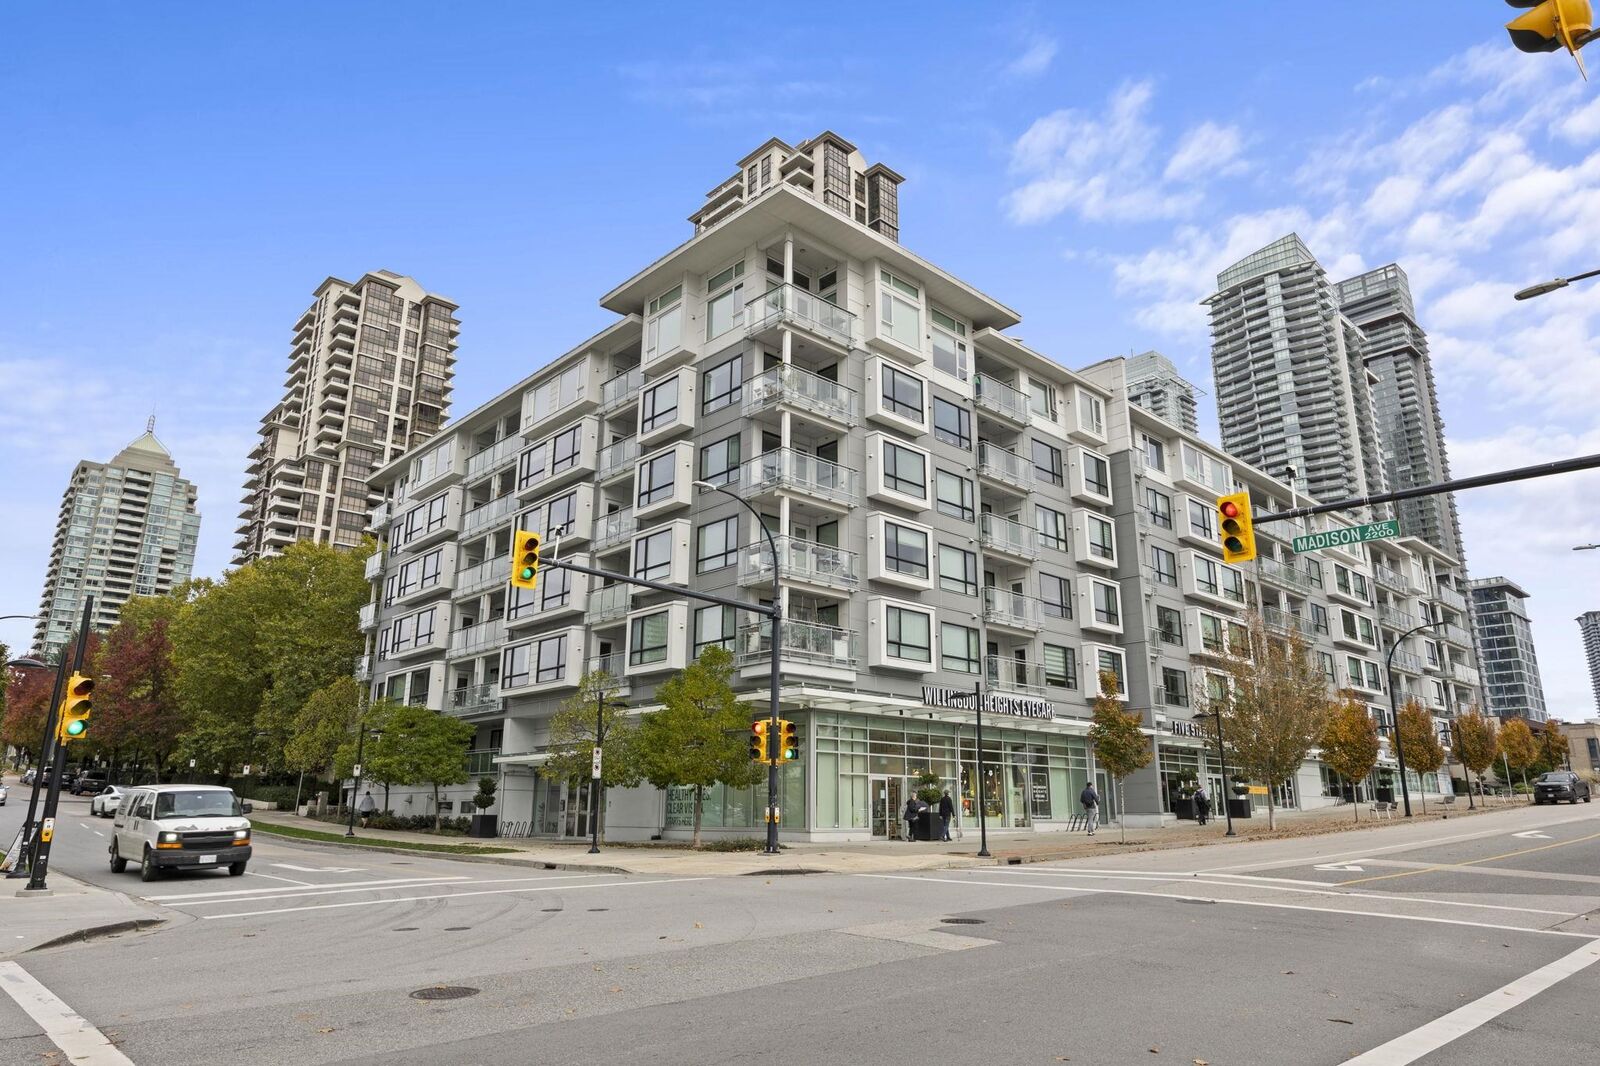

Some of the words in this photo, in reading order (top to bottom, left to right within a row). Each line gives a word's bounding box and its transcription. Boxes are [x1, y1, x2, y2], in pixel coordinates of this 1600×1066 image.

[1297, 528, 1361, 551] MADISON
[1368, 522, 1389, 533] AVE
[1365, 528, 1394, 540] 2200
[984, 694, 1019, 716] HEIGHTS
[1022, 699, 1056, 719] EYECARE
[1174, 721, 1190, 736] FIVE
